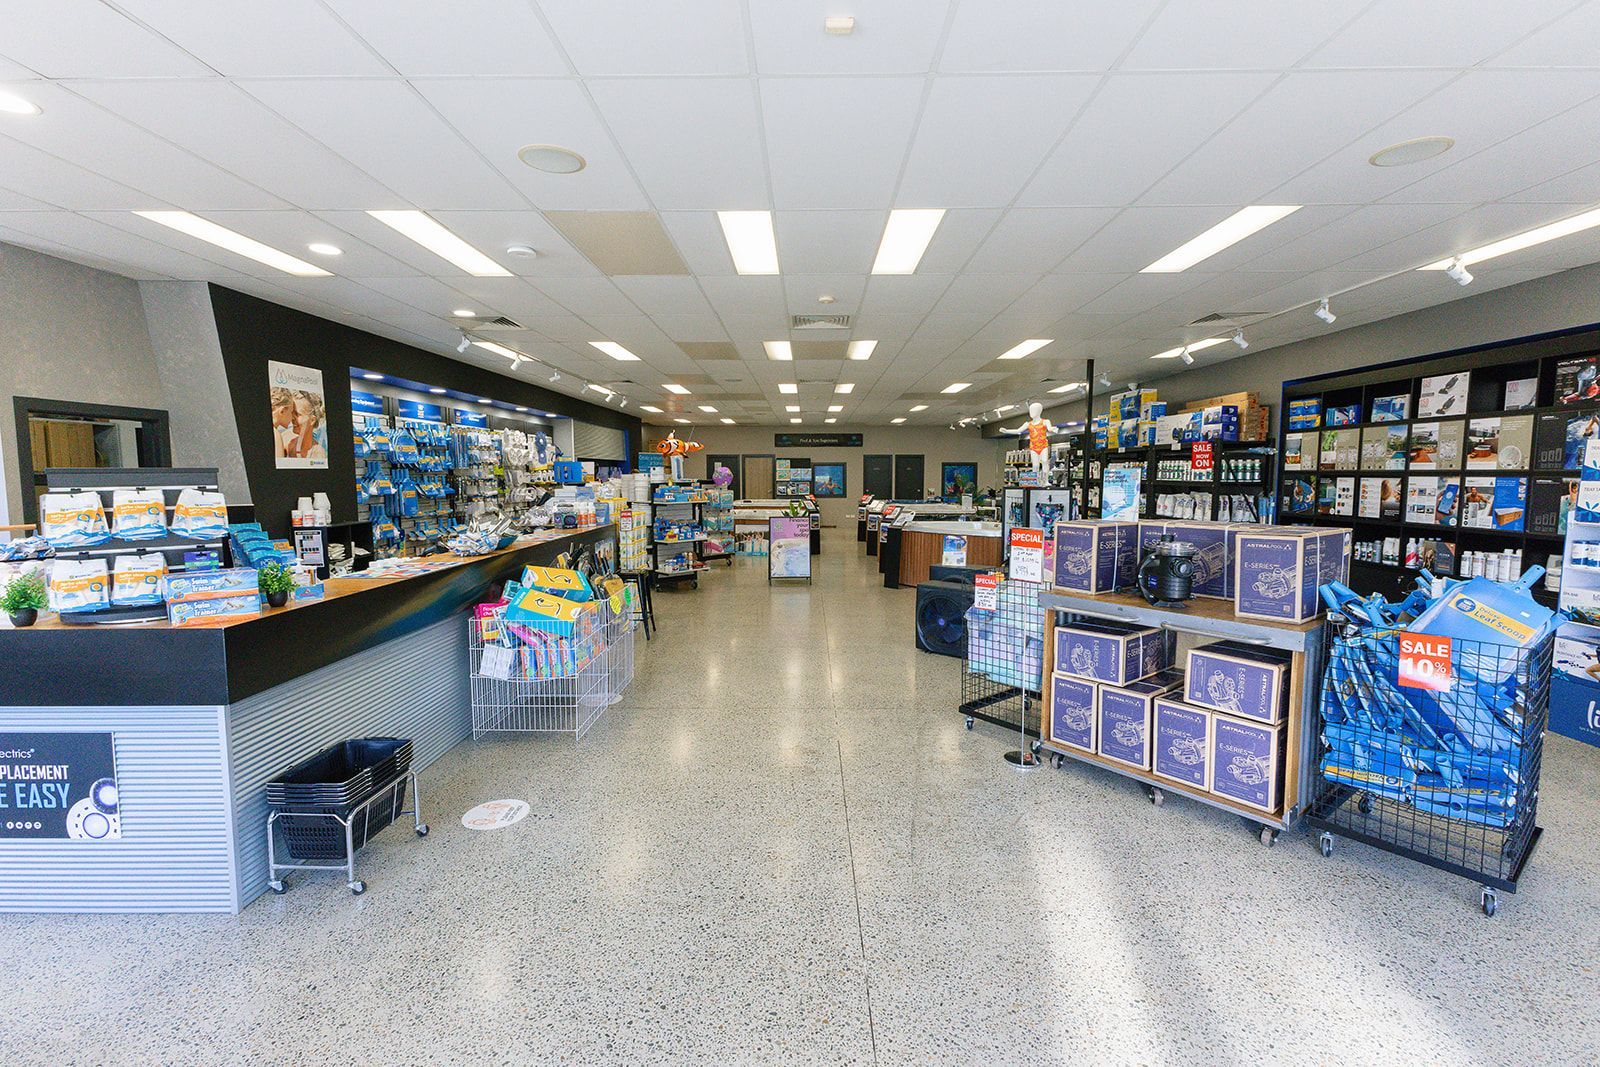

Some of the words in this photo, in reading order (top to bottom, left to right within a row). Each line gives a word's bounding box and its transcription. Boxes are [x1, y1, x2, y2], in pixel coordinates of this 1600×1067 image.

[1193, 444, 1212, 452] SALE
[1195, 459, 1209, 467] ON
[1011, 533, 1042, 543] SPECIAL
[1474, 611, 1497, 624] Leaf
[1496, 621, 1526, 640] Scoop
[1401, 639, 1449, 658] SALE
[1161, 726, 1187, 738] E-SERIES
[1219, 743, 1248, 755] E-SERIES
[15, 783, 70, 808] EASY
